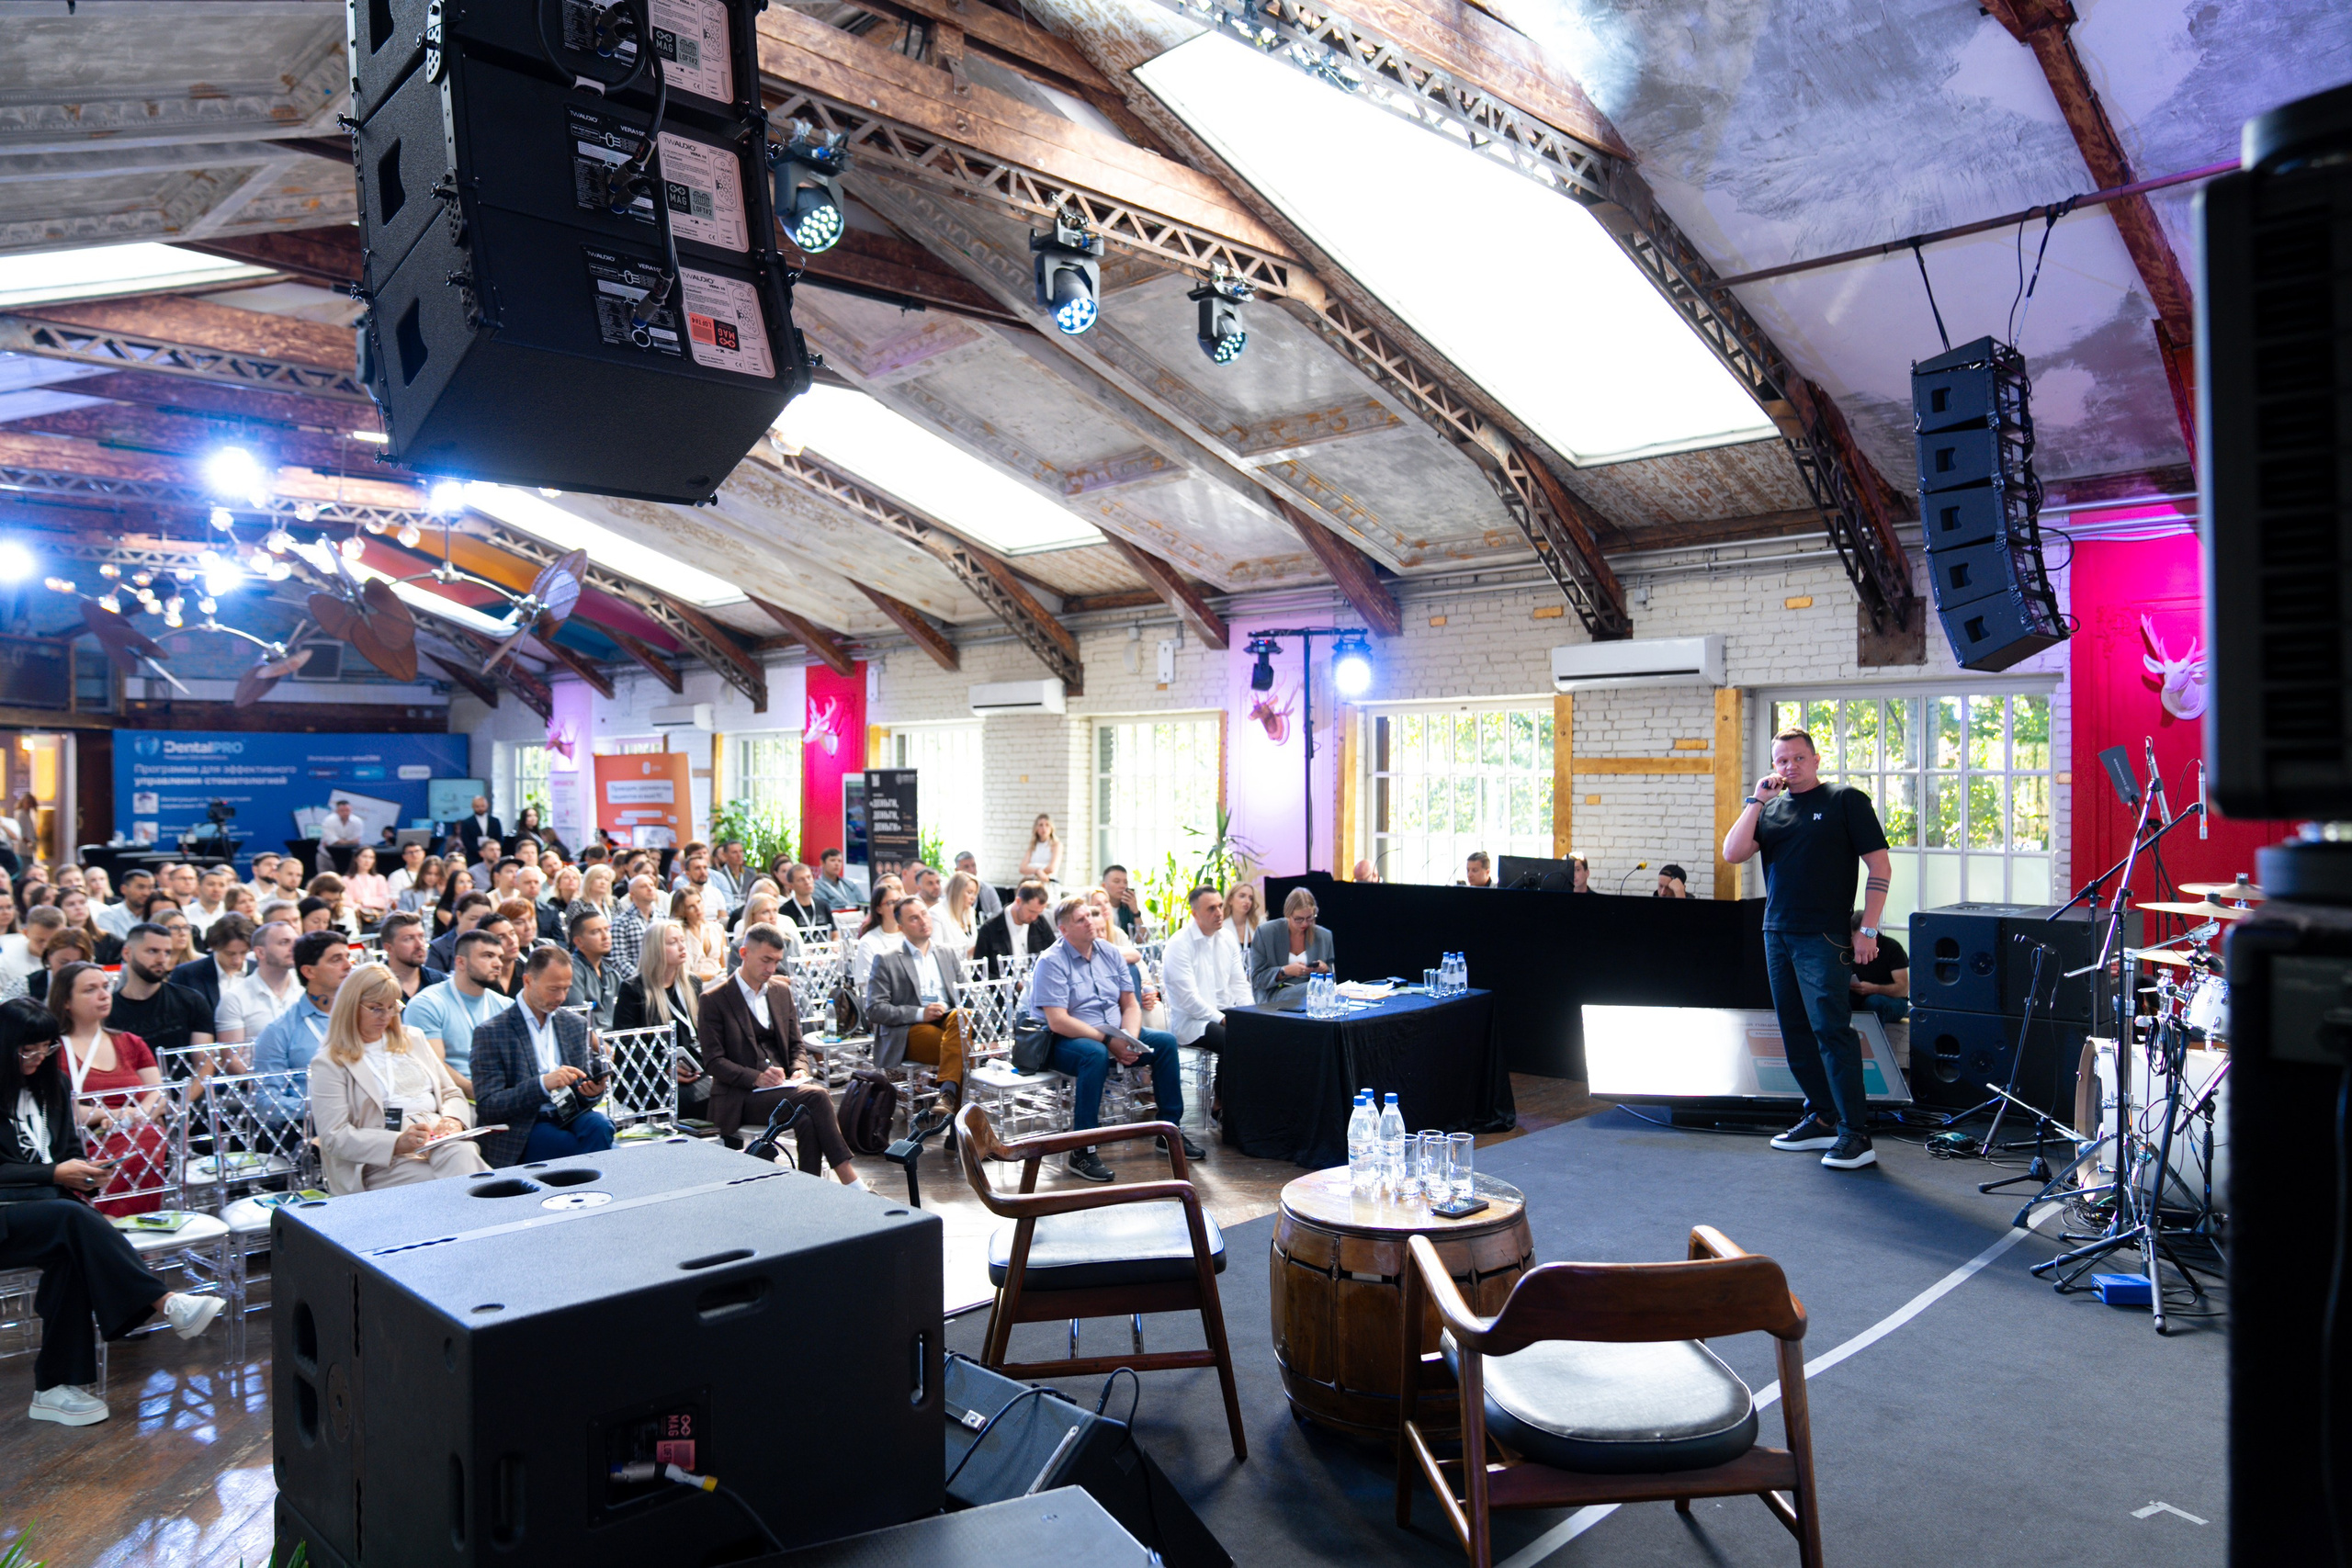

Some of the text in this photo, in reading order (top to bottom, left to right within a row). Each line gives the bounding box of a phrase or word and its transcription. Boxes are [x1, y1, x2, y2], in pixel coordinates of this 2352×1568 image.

[656, 39, 673, 52] MAG
[679, 52, 698, 65] LOFT#2
[570, 110, 598, 123] TWAUDIO
[663, 137, 696, 152] TWAUDIO
[670, 194, 687, 206] MAG
[693, 204, 712, 216] LOFT#2
[587, 251, 616, 262] TWAUDIO
[681, 272, 714, 284] TWAUDIO
[692, 317, 712, 328] LOFT#4
[718, 328, 735, 340] MAG
[133, 763, 198, 775] Программа
[200, 766, 221, 775] для
[222, 764, 298, 775] эффективного
[133, 776, 203, 787] управления
[668, 1415, 679, 1437] MAG
[663, 1443, 673, 1463] LOFT
